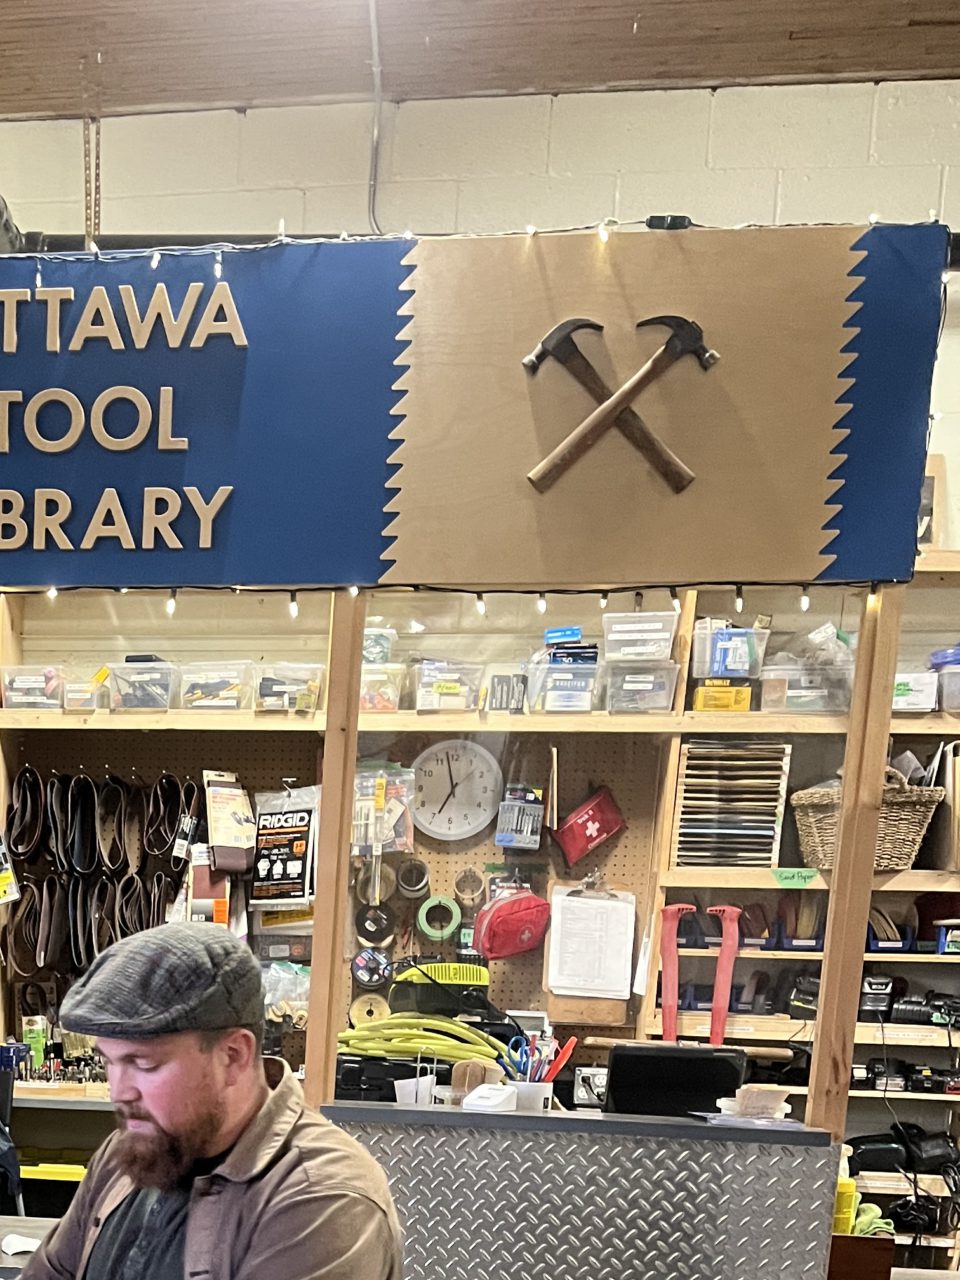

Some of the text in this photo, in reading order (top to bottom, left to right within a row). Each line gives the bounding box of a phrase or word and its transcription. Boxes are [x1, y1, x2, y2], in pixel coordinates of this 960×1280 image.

[436, 758, 444, 766] 11
[451, 754, 460, 762] 12
[423, 769, 433, 778] 10
[259, 812, 310, 829] RIDGID
